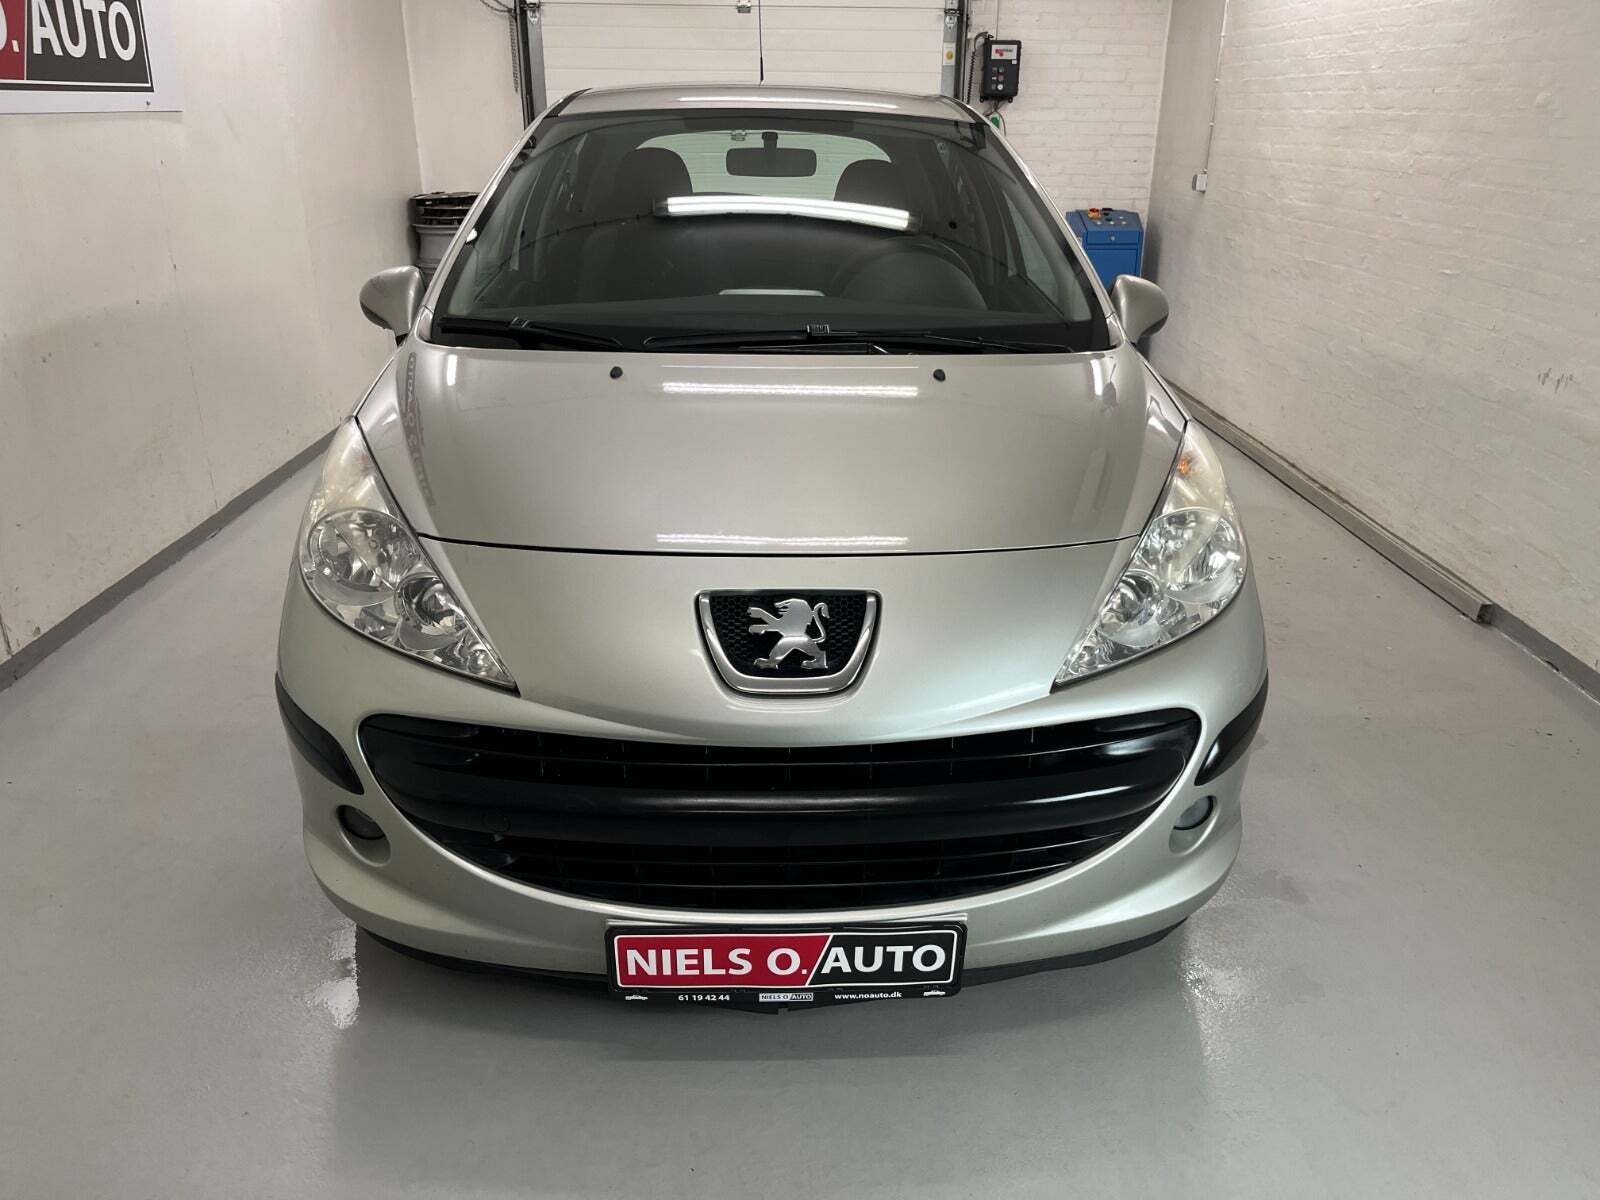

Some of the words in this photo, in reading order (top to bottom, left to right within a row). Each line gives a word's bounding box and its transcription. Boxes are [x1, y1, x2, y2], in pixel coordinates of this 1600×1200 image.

[31, 0, 136, 61] AUTO
[626, 948, 752, 976] NIELS
[766, 948, 808, 976] O.
[820, 945, 947, 974] AUTO
[834, 991, 902, 999] www.noauto.dk
